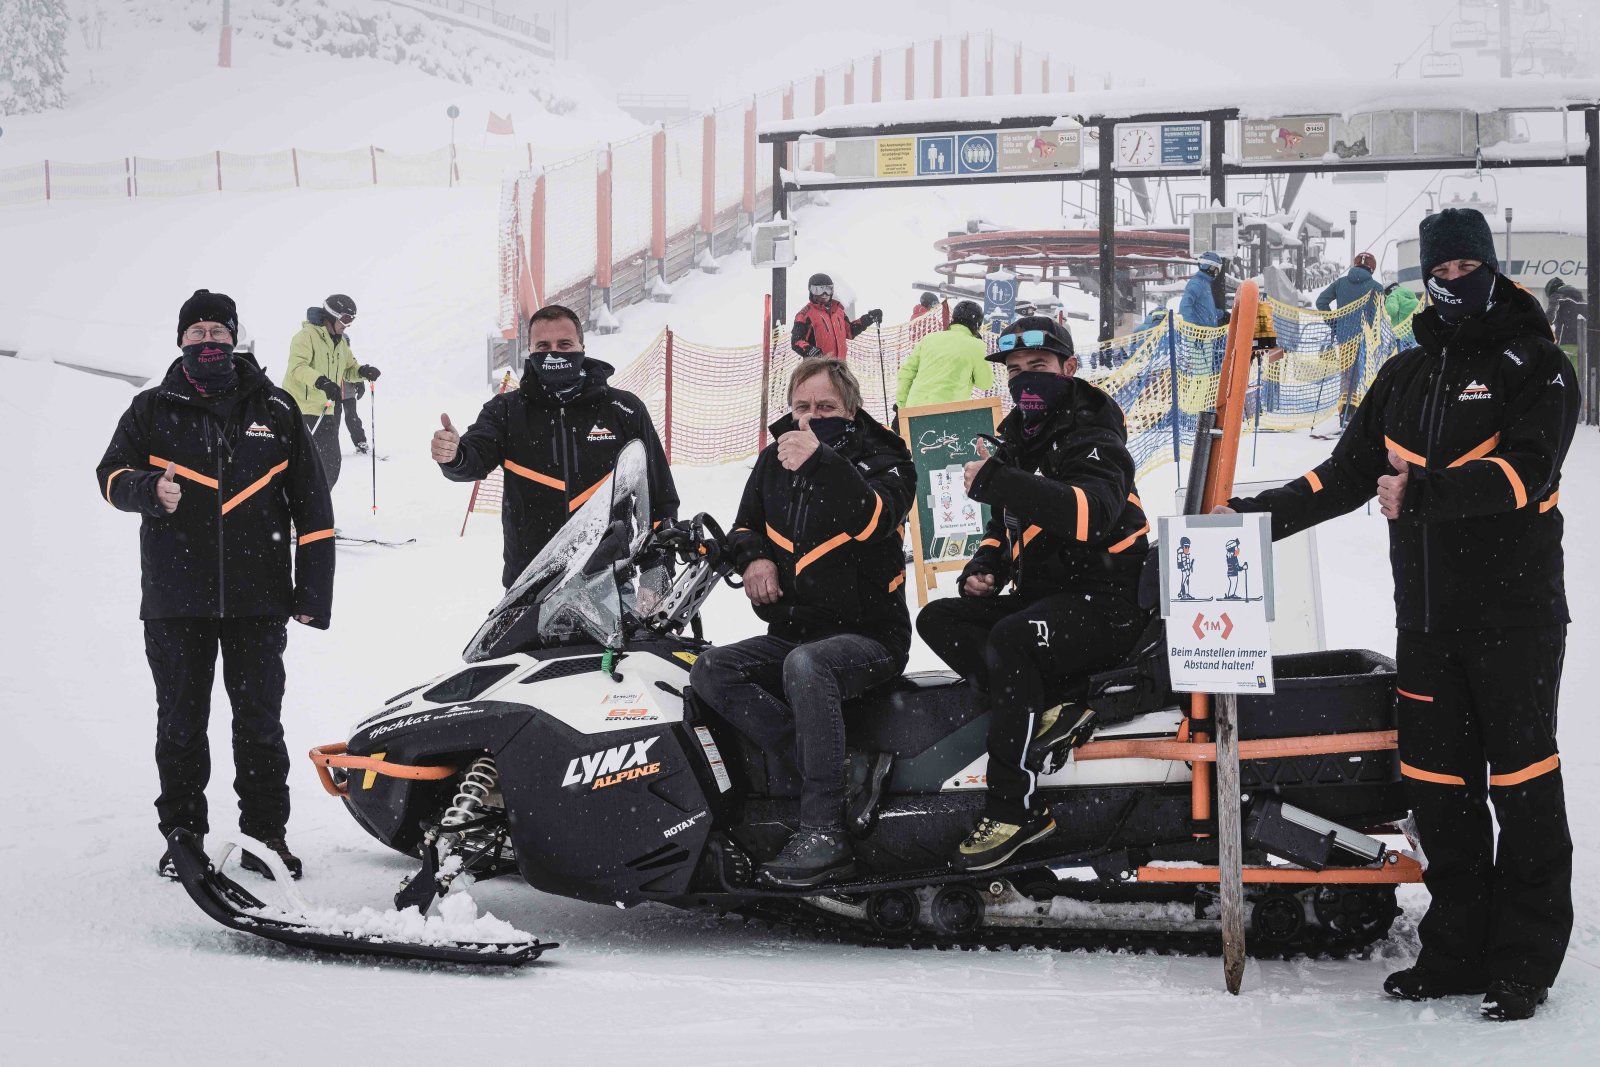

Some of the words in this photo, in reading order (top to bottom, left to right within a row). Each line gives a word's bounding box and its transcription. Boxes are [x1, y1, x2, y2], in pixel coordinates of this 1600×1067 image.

[198, 354, 227, 363] Hochkar
[542, 362, 573, 370] Hochkar
[1458, 392, 1492, 401] Hochkar
[246, 430, 275, 438] Hochkar
[587, 434, 616, 442] Hochkar
[1203, 621, 1221, 631] 1M
[1171, 647, 1192, 657] Beim
[1194, 648, 1235, 658] Anstellen
[1237, 648, 1267, 658] immer
[1184, 660, 1220, 670] Abstand
[1221, 660, 1255, 670] halten!
[369, 714, 431, 739] Hochkar
[433, 709, 484, 720] Bergbahnen
[561, 735, 660, 788] LYNX
[591, 762, 661, 790] ALPINE
[663, 818, 696, 839] ROTAX
